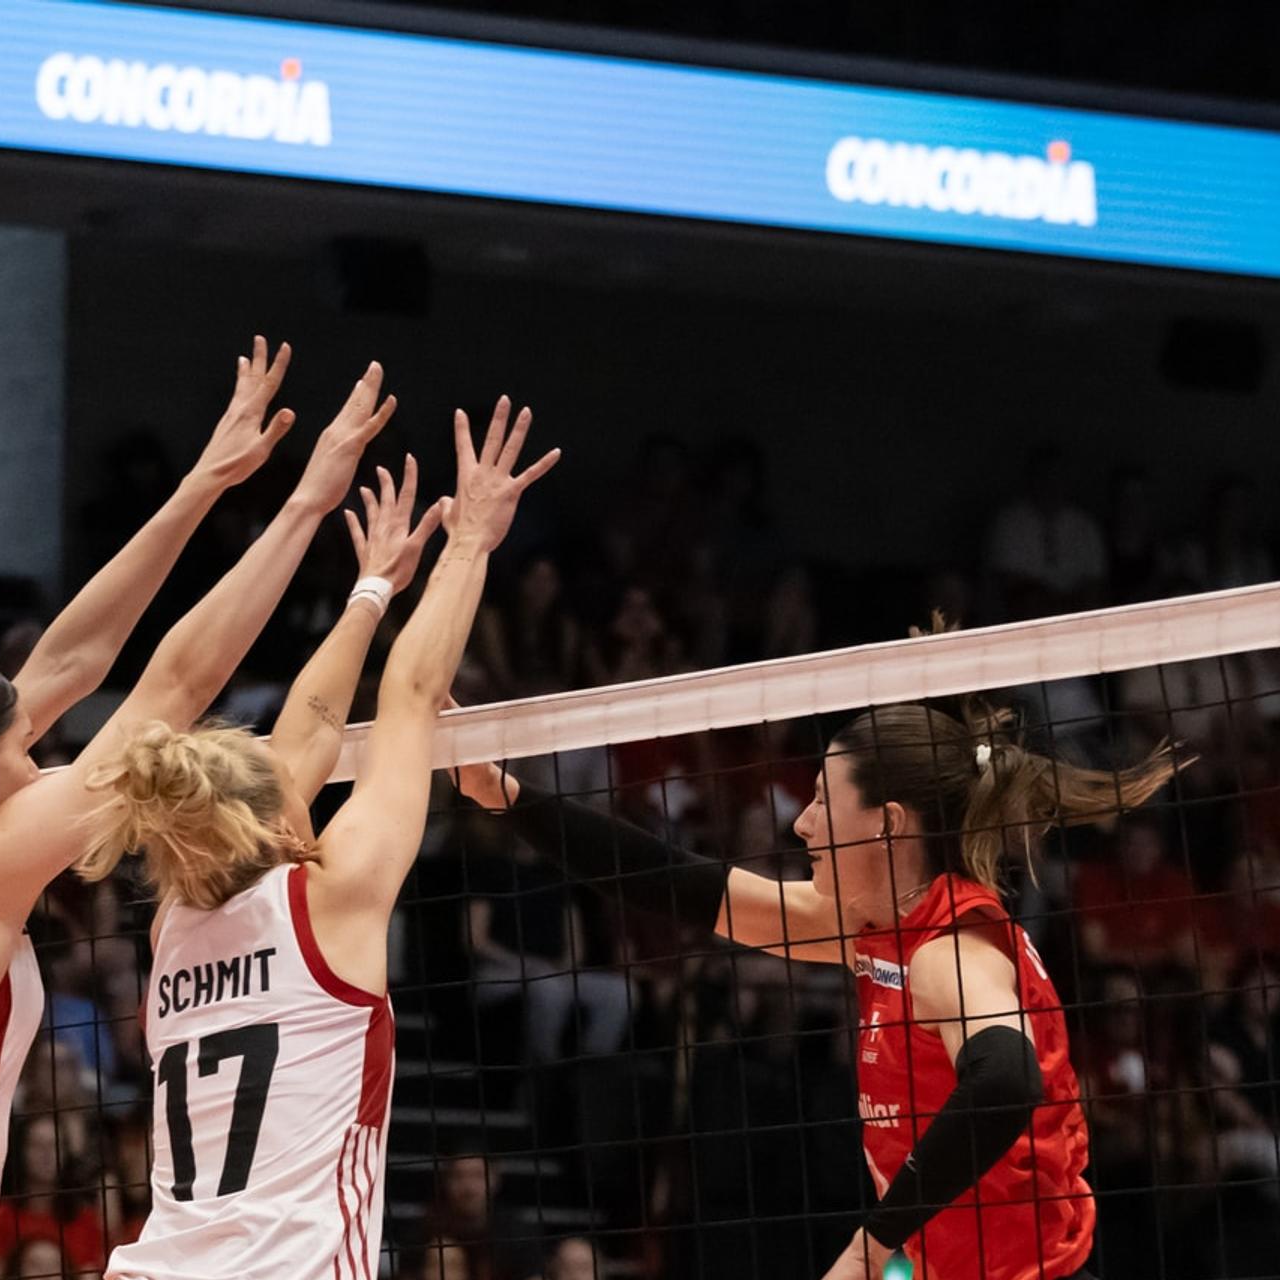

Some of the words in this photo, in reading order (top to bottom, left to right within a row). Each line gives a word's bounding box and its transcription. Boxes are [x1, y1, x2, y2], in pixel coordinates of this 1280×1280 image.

[35, 53, 333, 147] CONCORDIA
[826, 138, 1096, 227] CONCORDIA
[158, 948, 277, 1019] SCHMIT
[158, 1022, 280, 1202] 17
